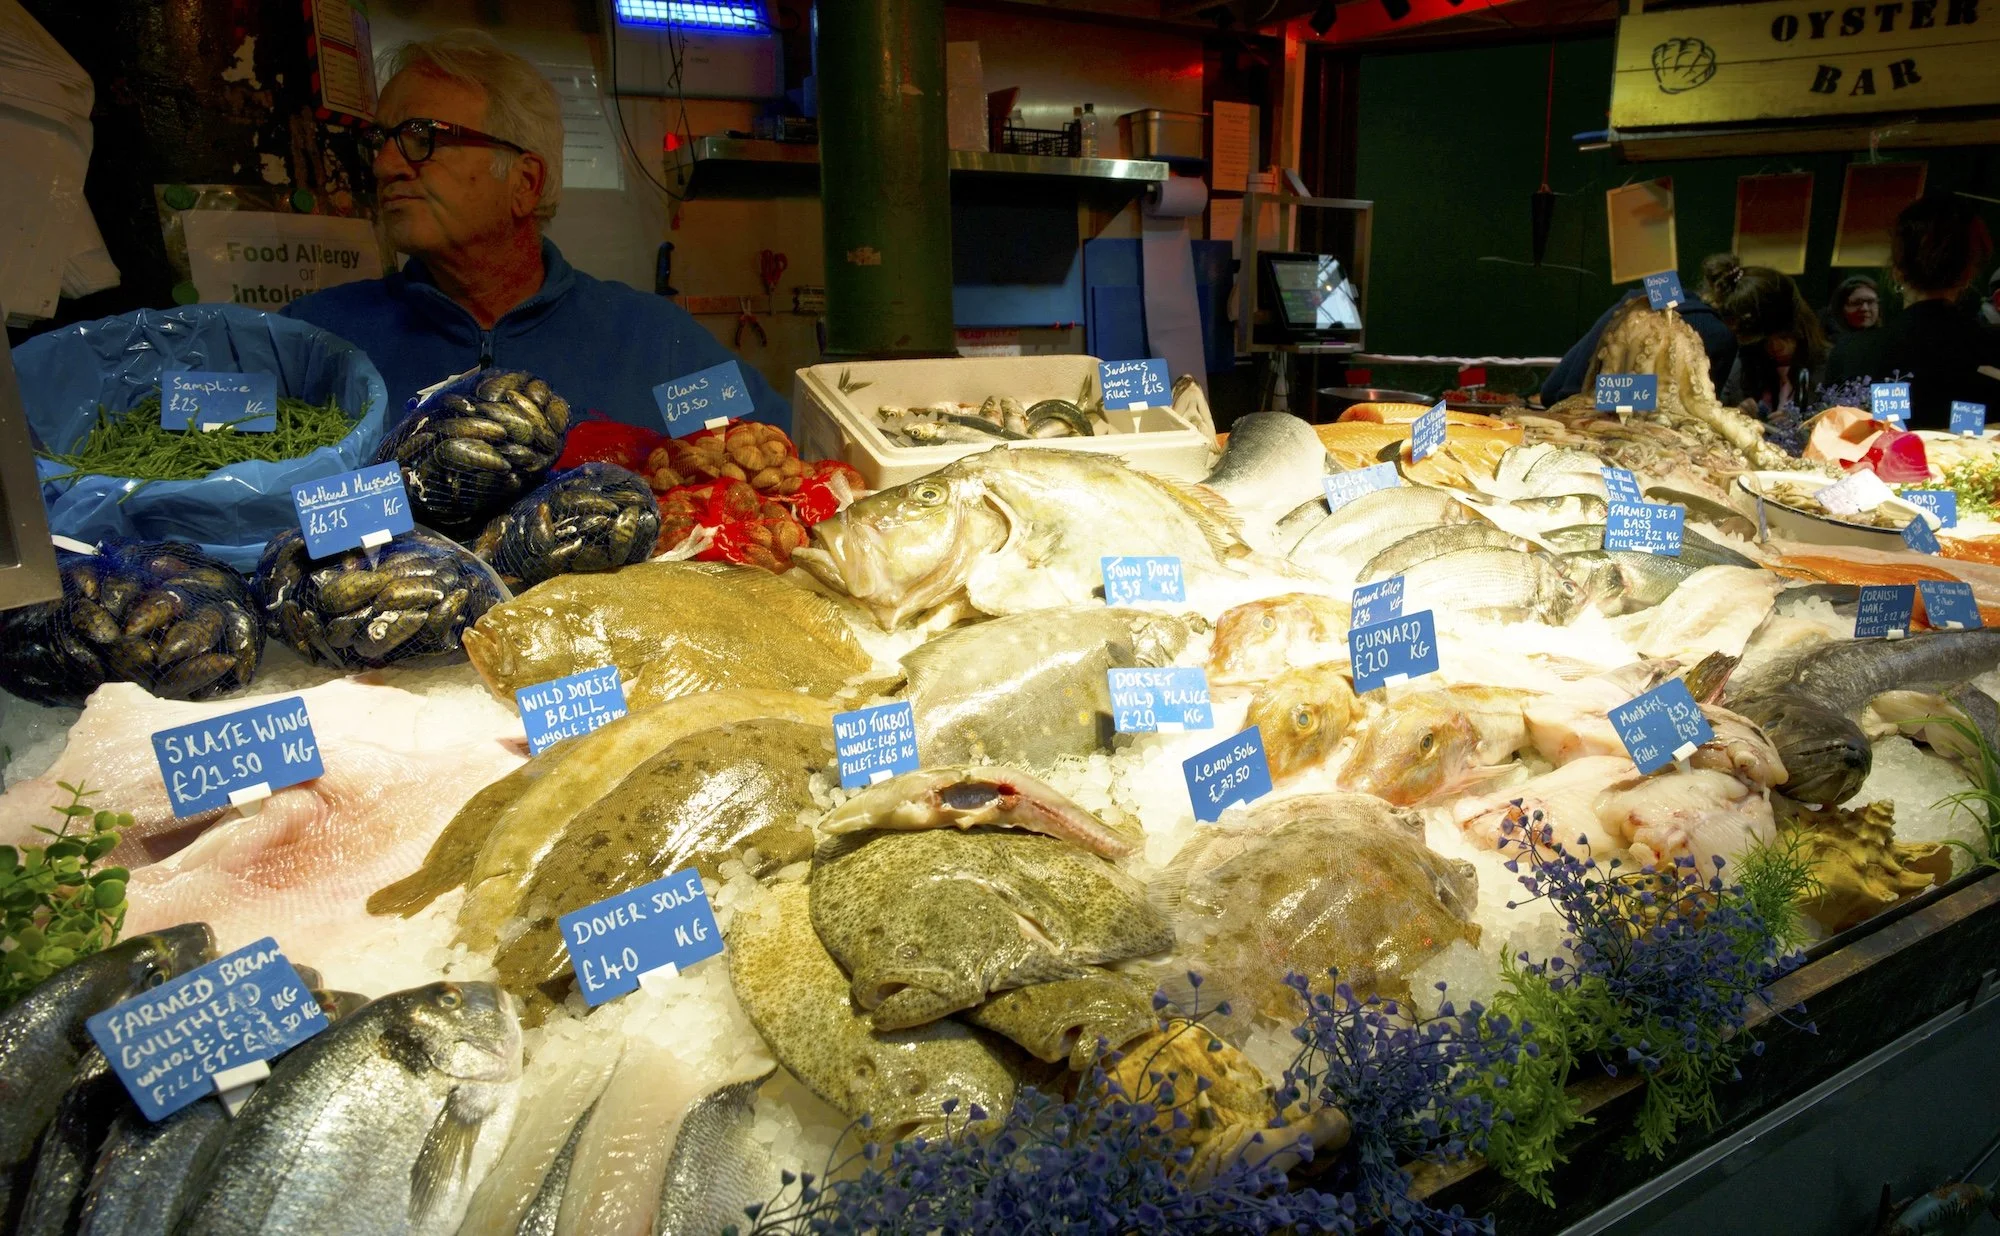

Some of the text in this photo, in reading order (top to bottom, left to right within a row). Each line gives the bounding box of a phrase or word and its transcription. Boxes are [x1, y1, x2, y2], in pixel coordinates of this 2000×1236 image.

[1771, 0, 1979, 42] OYSTER
[1809, 58, 1922, 96] BAR
[227, 242, 360, 269] Food Allergy
[299, 268, 315, 281] or
[1104, 361, 1148, 377] Sardines
[1142, 371, 1157, 385] £10
[173, 377, 250, 396] Samphire
[1144, 382, 1164, 395] £15
[1599, 377, 1633, 388] SQUID
[169, 393, 266, 413] £25 KG
[1596, 389, 1650, 404] £28 KG
[666, 398, 709, 422] £13.50
[354, 471, 401, 493] Mussels
[1327, 471, 1368, 492] BLACK
[310, 497, 402, 536] £6.75 KG
[1610, 504, 1676, 520] FARMED SEA
[1624, 519, 1651, 529] BASS
[1666, 531, 1679, 541] KG
[1107, 557, 1179, 582] JOHN DORY
[1161, 581, 1178, 594] KG
[1862, 590, 1898, 602] CORNISH
[1390, 596, 1404, 612] KG
[1862, 603, 1884, 613] HAKE
[1356, 621, 1420, 652] GURNARD
[1355, 641, 1430, 680] £20 KG
[522, 670, 618, 712] WILD DORSET
[1115, 672, 1175, 689] DORSET
[1113, 690, 1210, 708] WILD PLAICE
[545, 699, 605, 728] BRILL
[588, 712, 610, 732] £28
[611, 709, 626, 720] KG
[836, 707, 910, 739] WILD TURBOT
[1120, 708, 1204, 731] £20 KG
[1667, 702, 1689, 726] £33
[165, 707, 309, 764] SKATE WING
[878, 731, 896, 748] £45
[900, 728, 912, 741] KG
[1633, 745, 1658, 764] Fillet
[1676, 720, 1699, 741] £43
[879, 748, 897, 765] £65
[901, 744, 914, 758] KG
[172, 738, 314, 803] £21.50 KG
[573, 879, 705, 945] DOVER SOLE
[582, 918, 708, 992] £40 KG
[272, 986, 299, 1011] KG
[107, 977, 213, 1044] FARMED
[300, 1001, 321, 1020] KG
[121, 983, 261, 1070] GUILTHEAD
